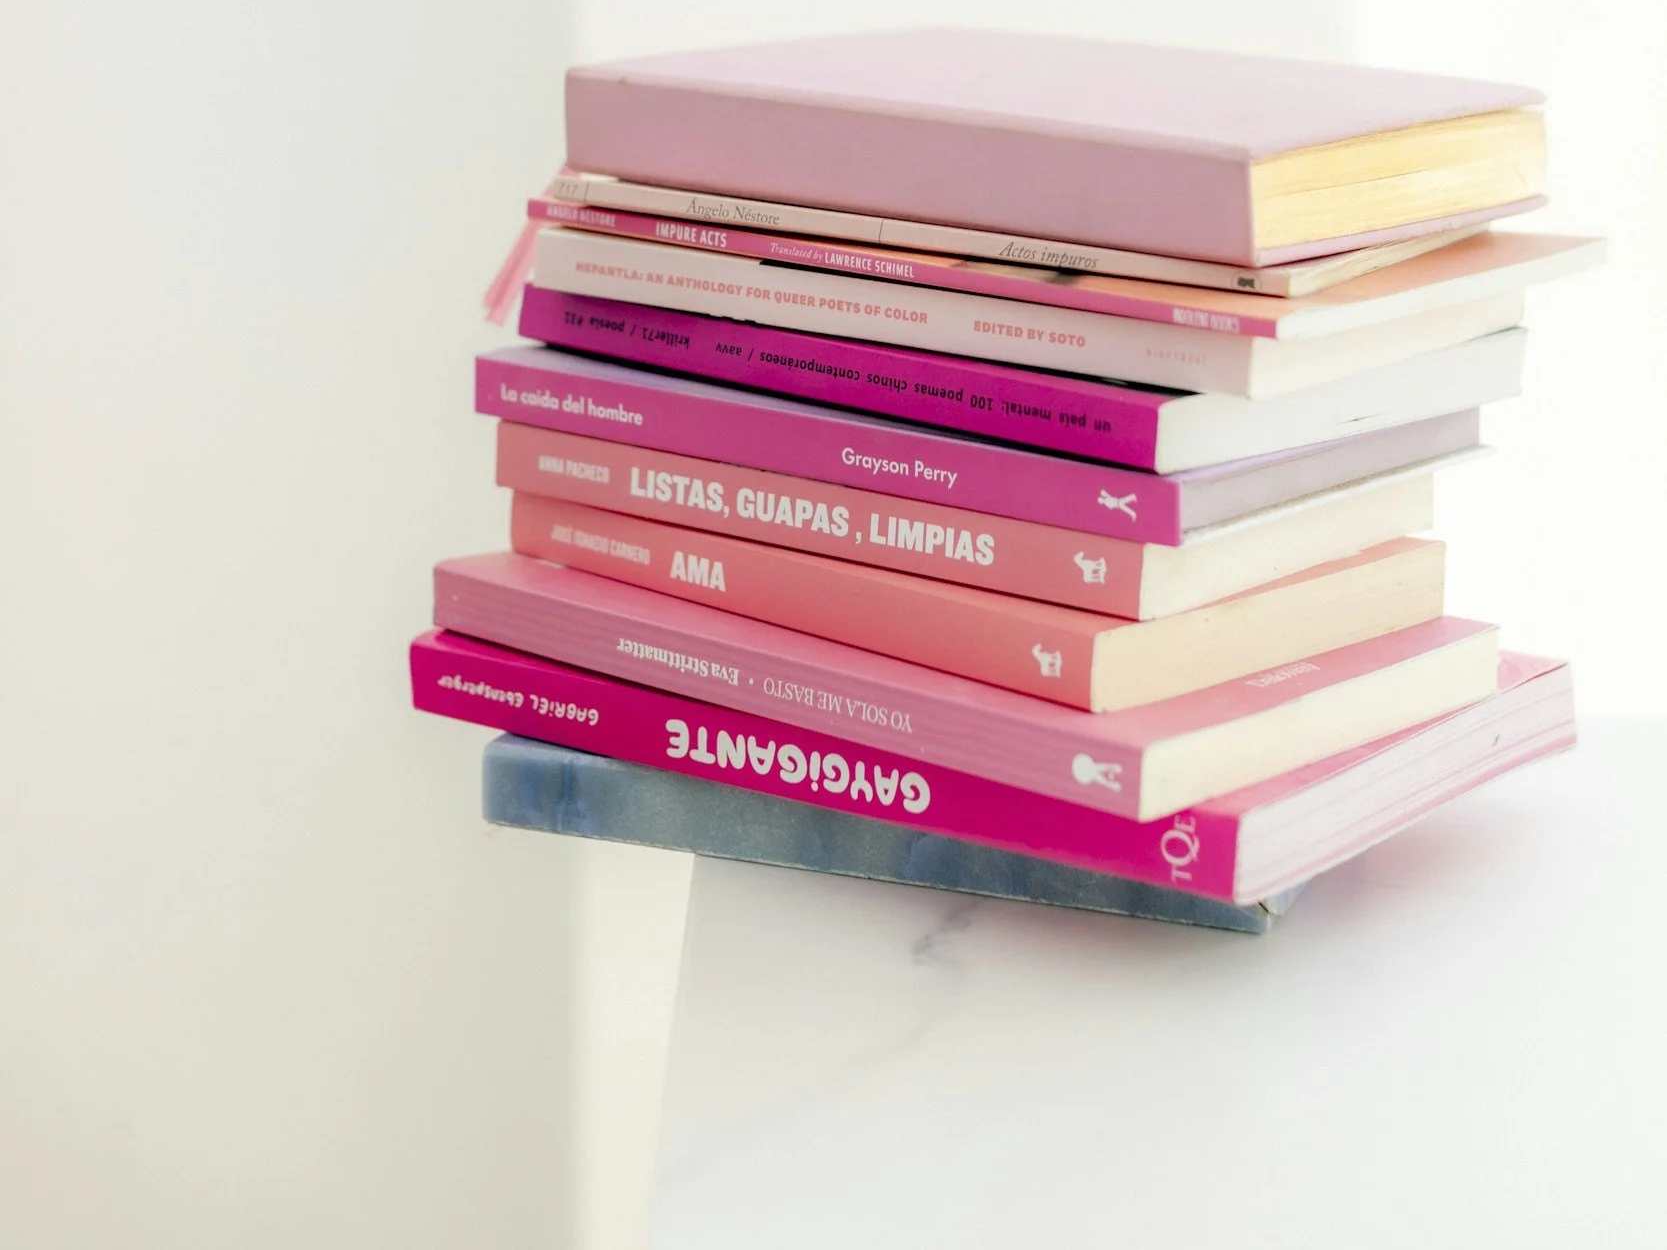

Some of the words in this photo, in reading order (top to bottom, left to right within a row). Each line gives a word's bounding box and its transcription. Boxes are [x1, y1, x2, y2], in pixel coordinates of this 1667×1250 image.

[686, 199, 730, 221] Ángelo
[734, 207, 780, 225] Néstore
[655, 222, 696, 244] IMPURE
[699, 227, 727, 248] ACTS
[770, 242, 812, 259] Translated
[814, 249, 823, 262] by
[825, 251, 872, 271] LAWRENCE
[875, 259, 914, 279] SCHIMEL
[998, 240, 1036, 260] Actos
[1040, 246, 1099, 269] impuros
[575, 261, 644, 281] NEPANTLA:
[646, 272, 664, 285] AN
[667, 275, 742, 296] ANTHOLOGY
[746, 286, 770, 301] FOR
[774, 290, 816, 308] QUEER
[819, 298, 860, 314] POETS
[864, 304, 880, 317] OF
[884, 307, 928, 324] COLOR
[642, 326, 689, 349] kriller71
[973, 320, 1023, 338] EDITED
[1027, 327, 1044, 342] BY
[1048, 330, 1086, 347] SOTO
[715, 343, 742, 359] aavv
[759, 352, 860, 382] contemporáneos
[866, 373, 908, 393] chinos
[914, 382, 964, 404] poemas
[500, 383, 517, 402] La
[562, 394, 584, 414] del
[588, 398, 643, 425] hombre
[970, 394, 994, 411] 100
[1001, 401, 1051, 421] mental:
[1093, 420, 1112, 434] un
[538, 455, 564, 475] ANNA
[566, 460, 610, 484] PACHECO
[841, 446, 909, 476] Grayson
[914, 460, 958, 490] Perry
[630, 466, 730, 518] LISTAS,
[737, 487, 849, 538] GUAPAS
[869, 512, 995, 566] LIMPIAS
[670, 551, 726, 592] AMA
[616, 637, 709, 678] Strittmatter
[711, 662, 740, 687] Eva
[763, 676, 814, 706] BASTO
[817, 691, 842, 715] ME
[846, 698, 888, 724] SOLA
[890, 711, 914, 734] YO
